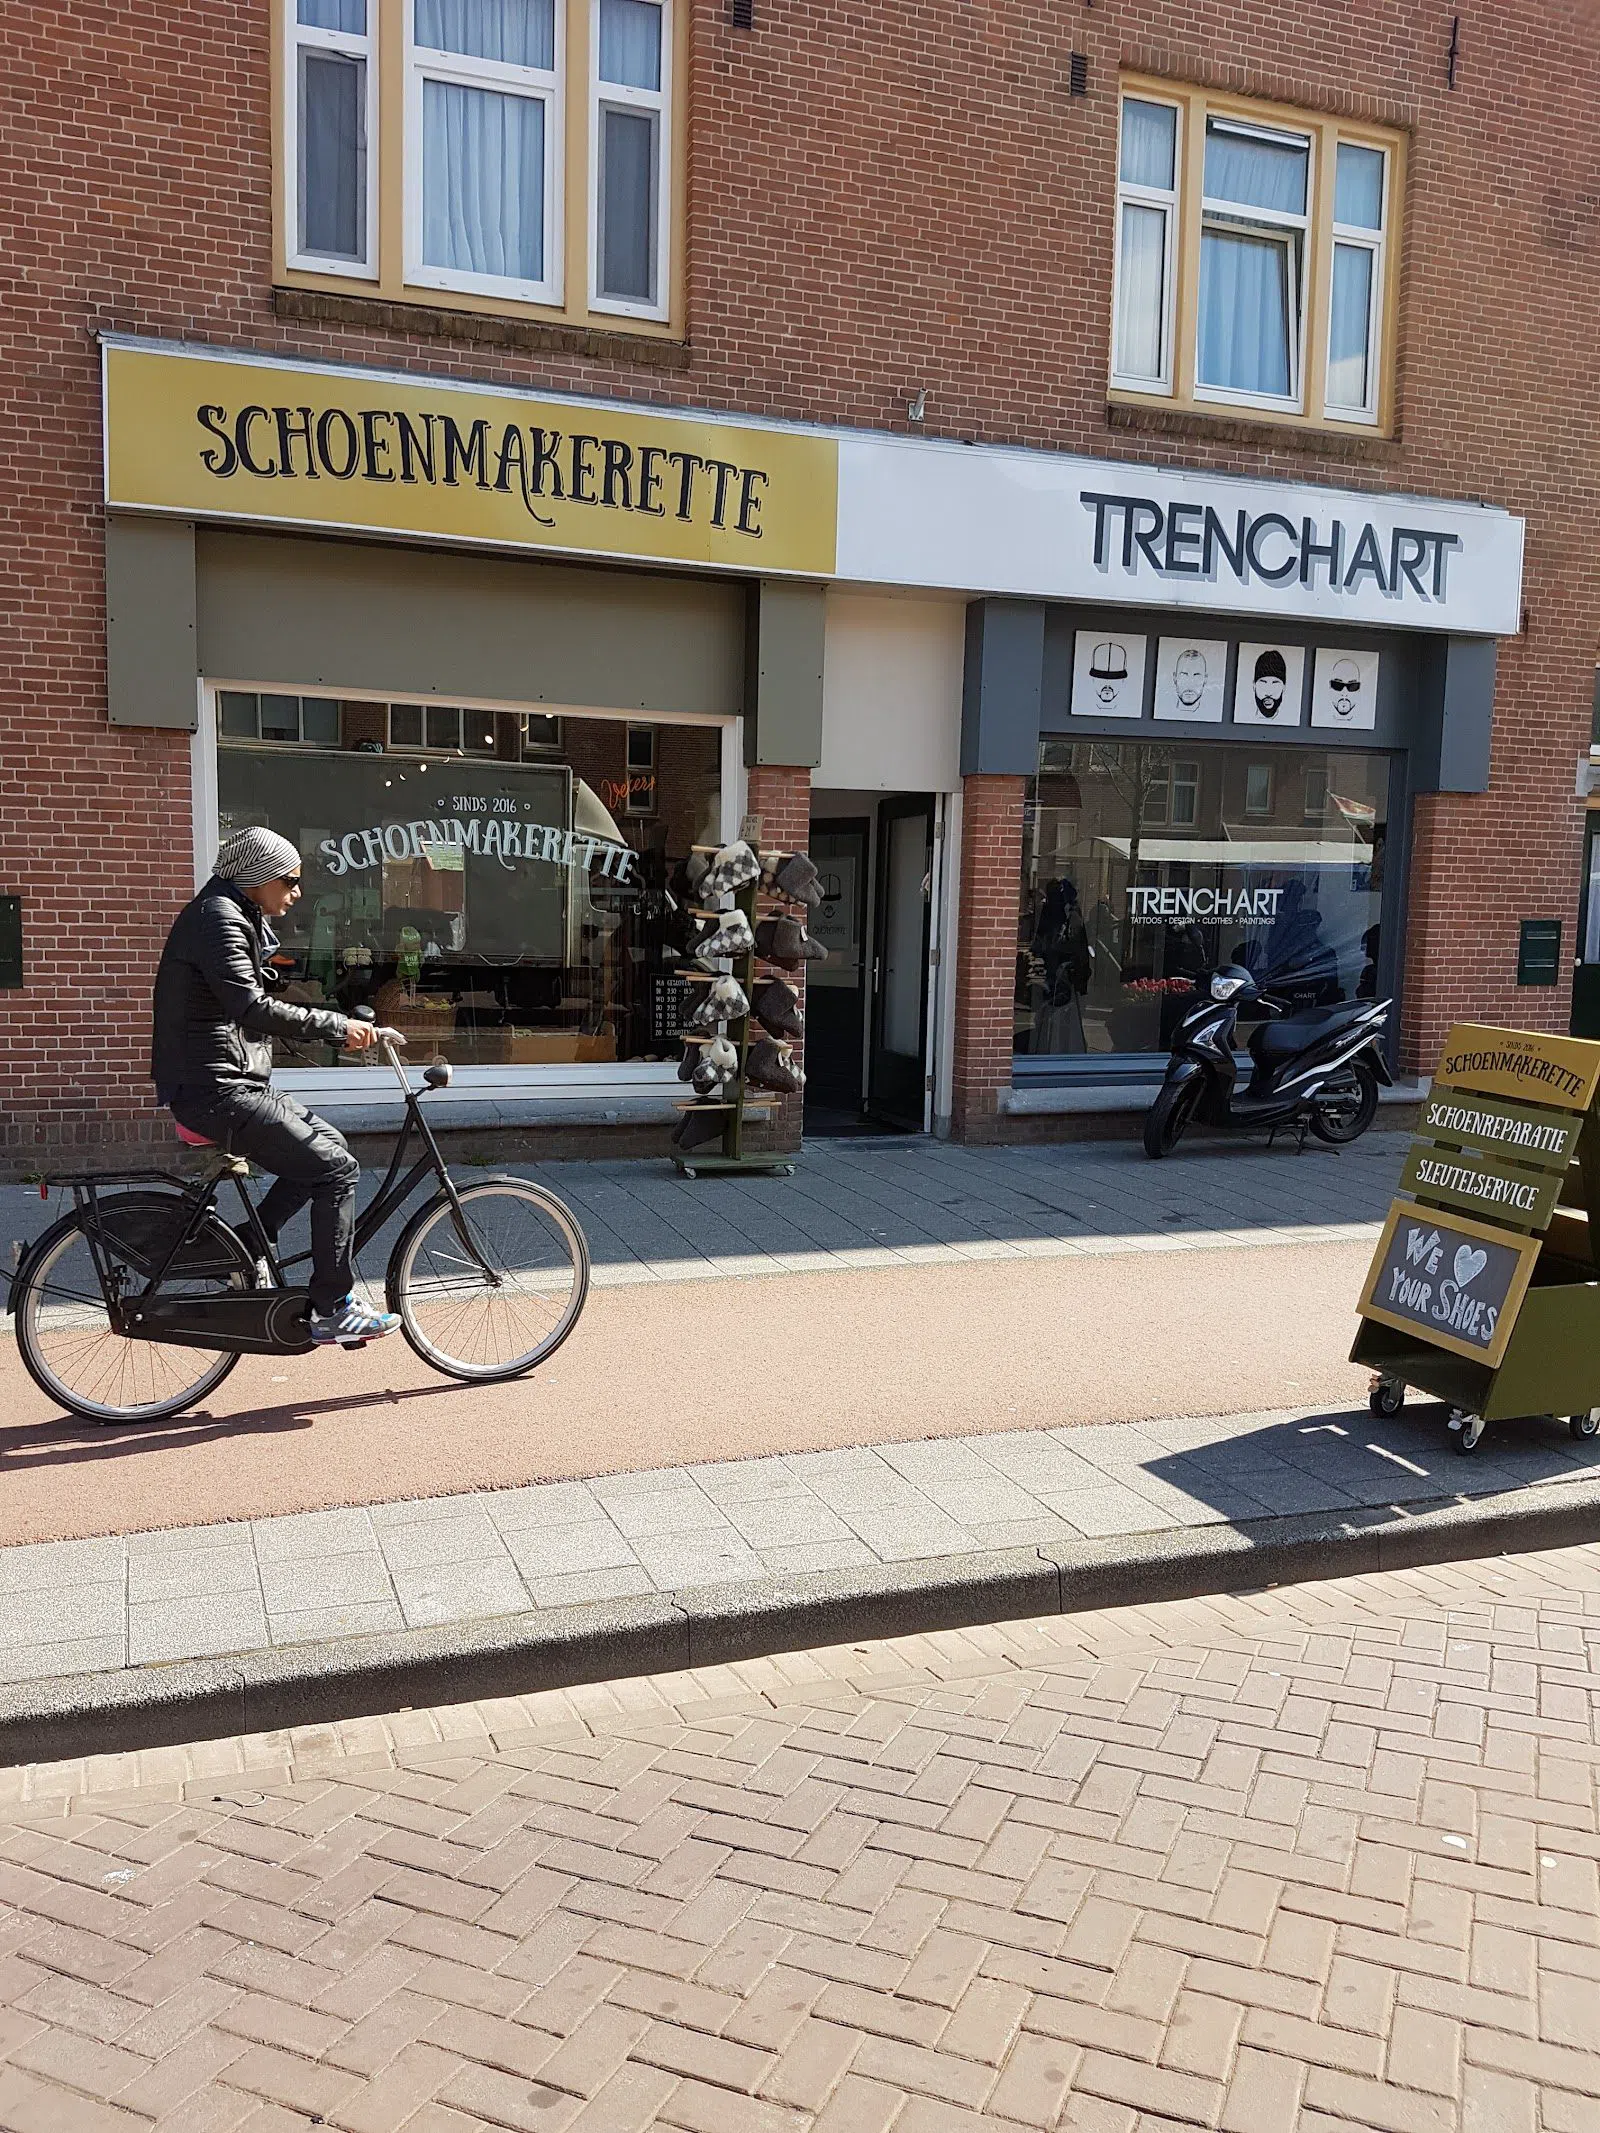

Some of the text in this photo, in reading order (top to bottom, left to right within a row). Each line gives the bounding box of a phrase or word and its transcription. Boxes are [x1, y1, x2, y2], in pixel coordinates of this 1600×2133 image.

[197, 404, 769, 538] SCHOENMAKERETTE
[1080, 491, 1461, 601] TRENCHART
[452, 796, 517, 813] SINDS 2016
[320, 818, 638, 884] SCHOENMAKERETTE
[1126, 887, 1284, 915] TRENCHART
[1131, 917, 1275, 925] TATTOOS DESIGN CLOTHES PAINTINGS
[1445, 1051, 1585, 1098] SCHOENMAKERETTE
[1427, 1103, 1568, 1153] SCHOENREPARATIE
[1416, 1159, 1539, 1211] SLEUTELSERVICE
[1406, 1228, 1443, 1275] WE
[1389, 1267, 1498, 1340] YOUR SHOES
